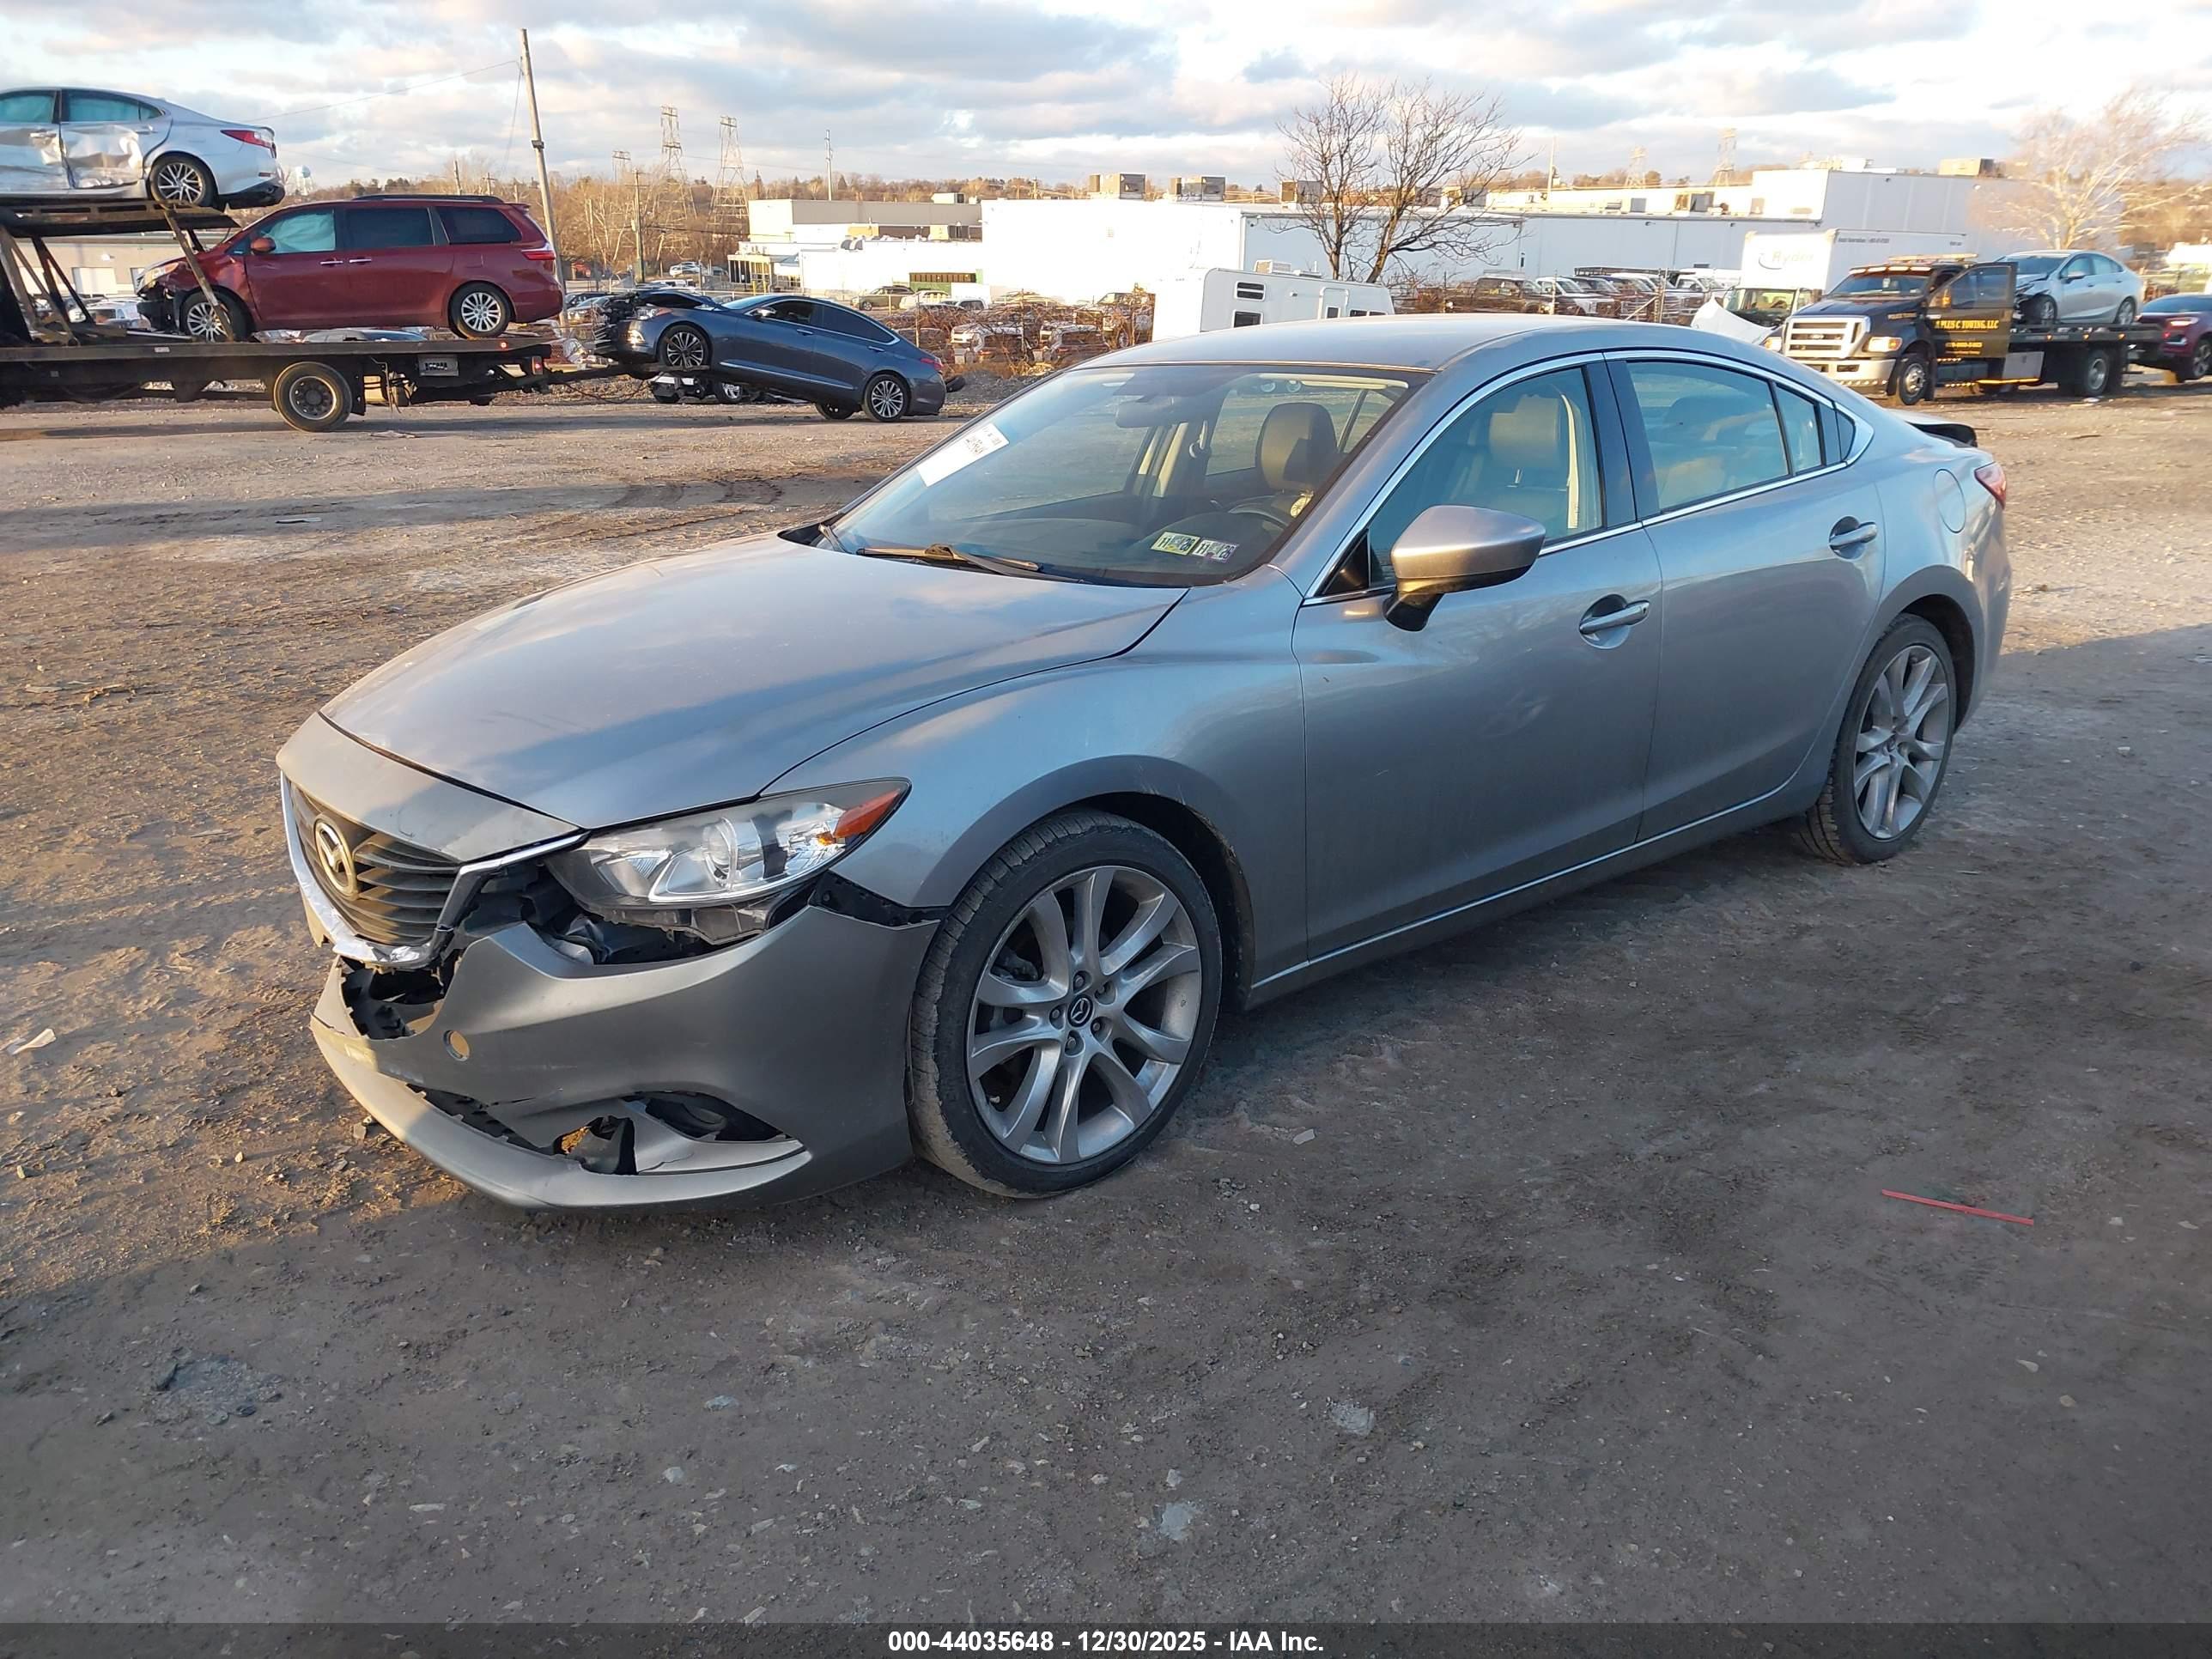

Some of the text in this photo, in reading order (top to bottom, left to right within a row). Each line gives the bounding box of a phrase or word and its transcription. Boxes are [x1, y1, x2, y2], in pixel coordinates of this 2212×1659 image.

[1987, 320, 2000, 329] LLC
[1158, 538, 1170, 548] 11
[1196, 544, 1210, 555] 11
